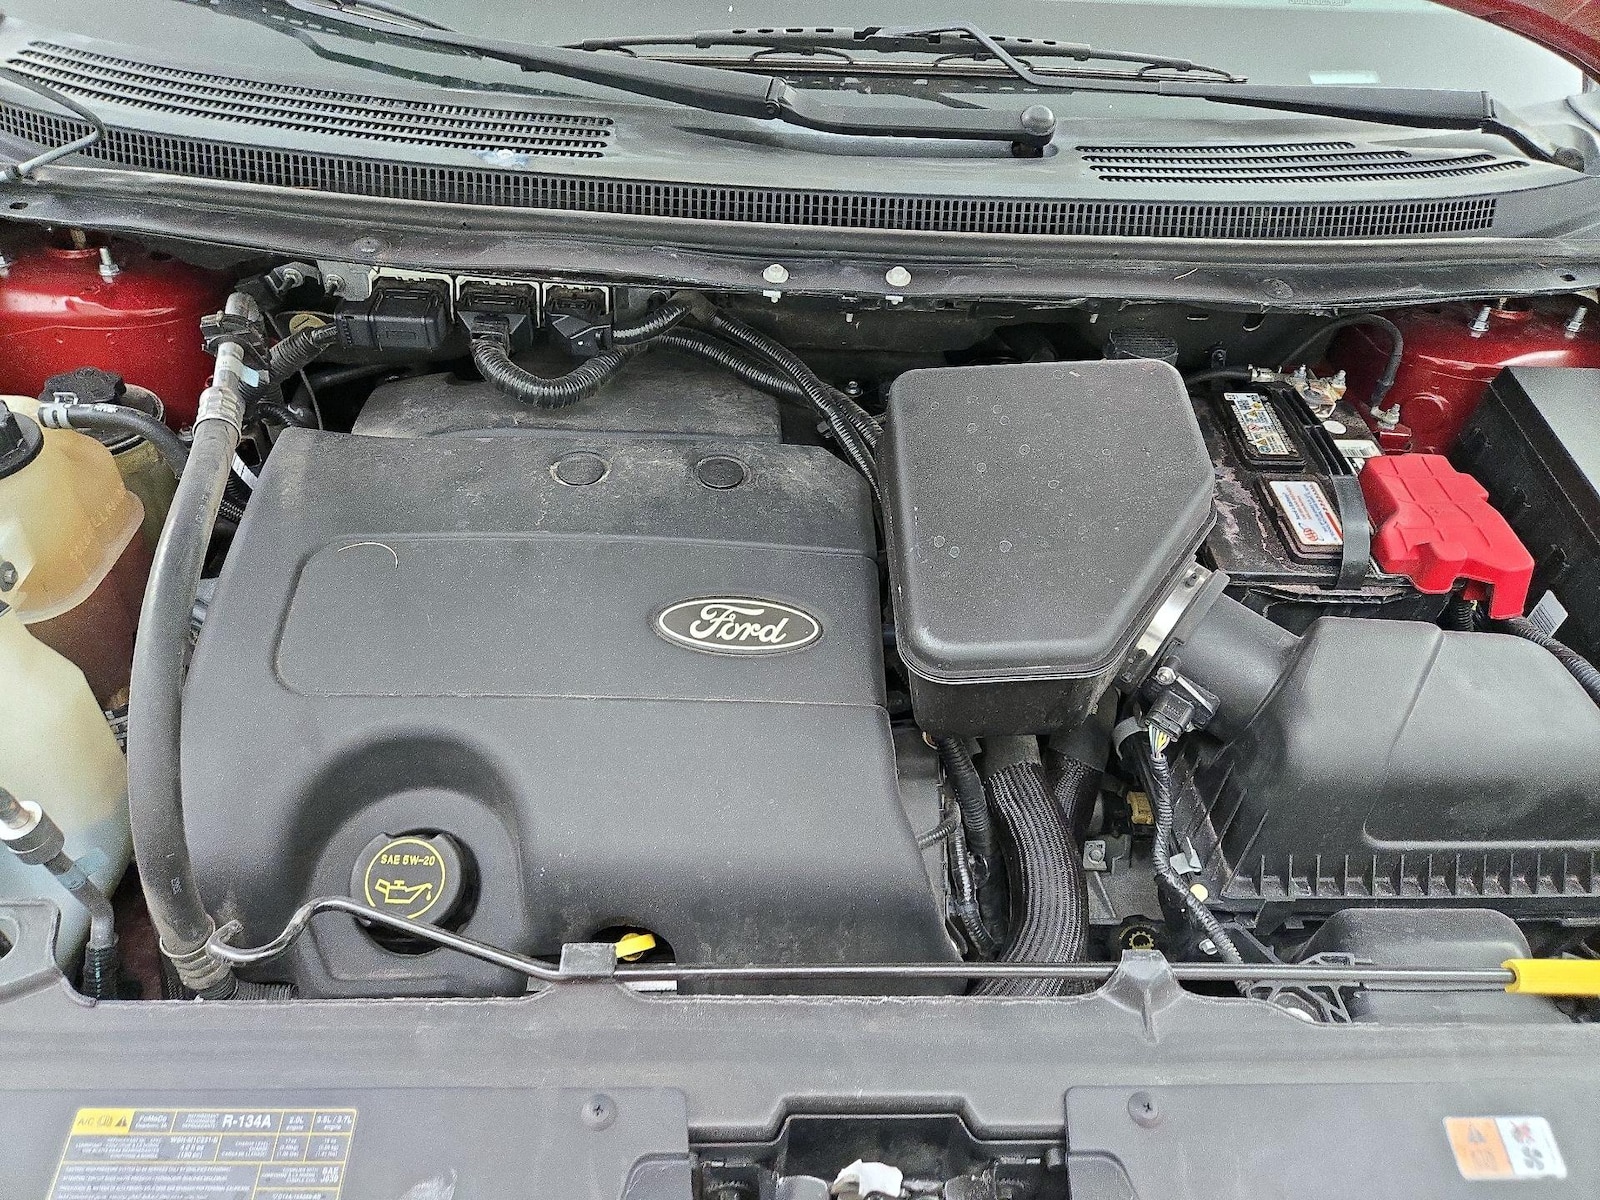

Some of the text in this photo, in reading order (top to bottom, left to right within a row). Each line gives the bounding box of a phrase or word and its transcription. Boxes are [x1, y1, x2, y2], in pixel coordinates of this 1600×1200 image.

[689, 603, 789, 644] Ford
[380, 854, 436, 866] SAE 5W-20
[78, 1117, 95, 1127] A/C
[222, 1113, 272, 1129] R-134A
